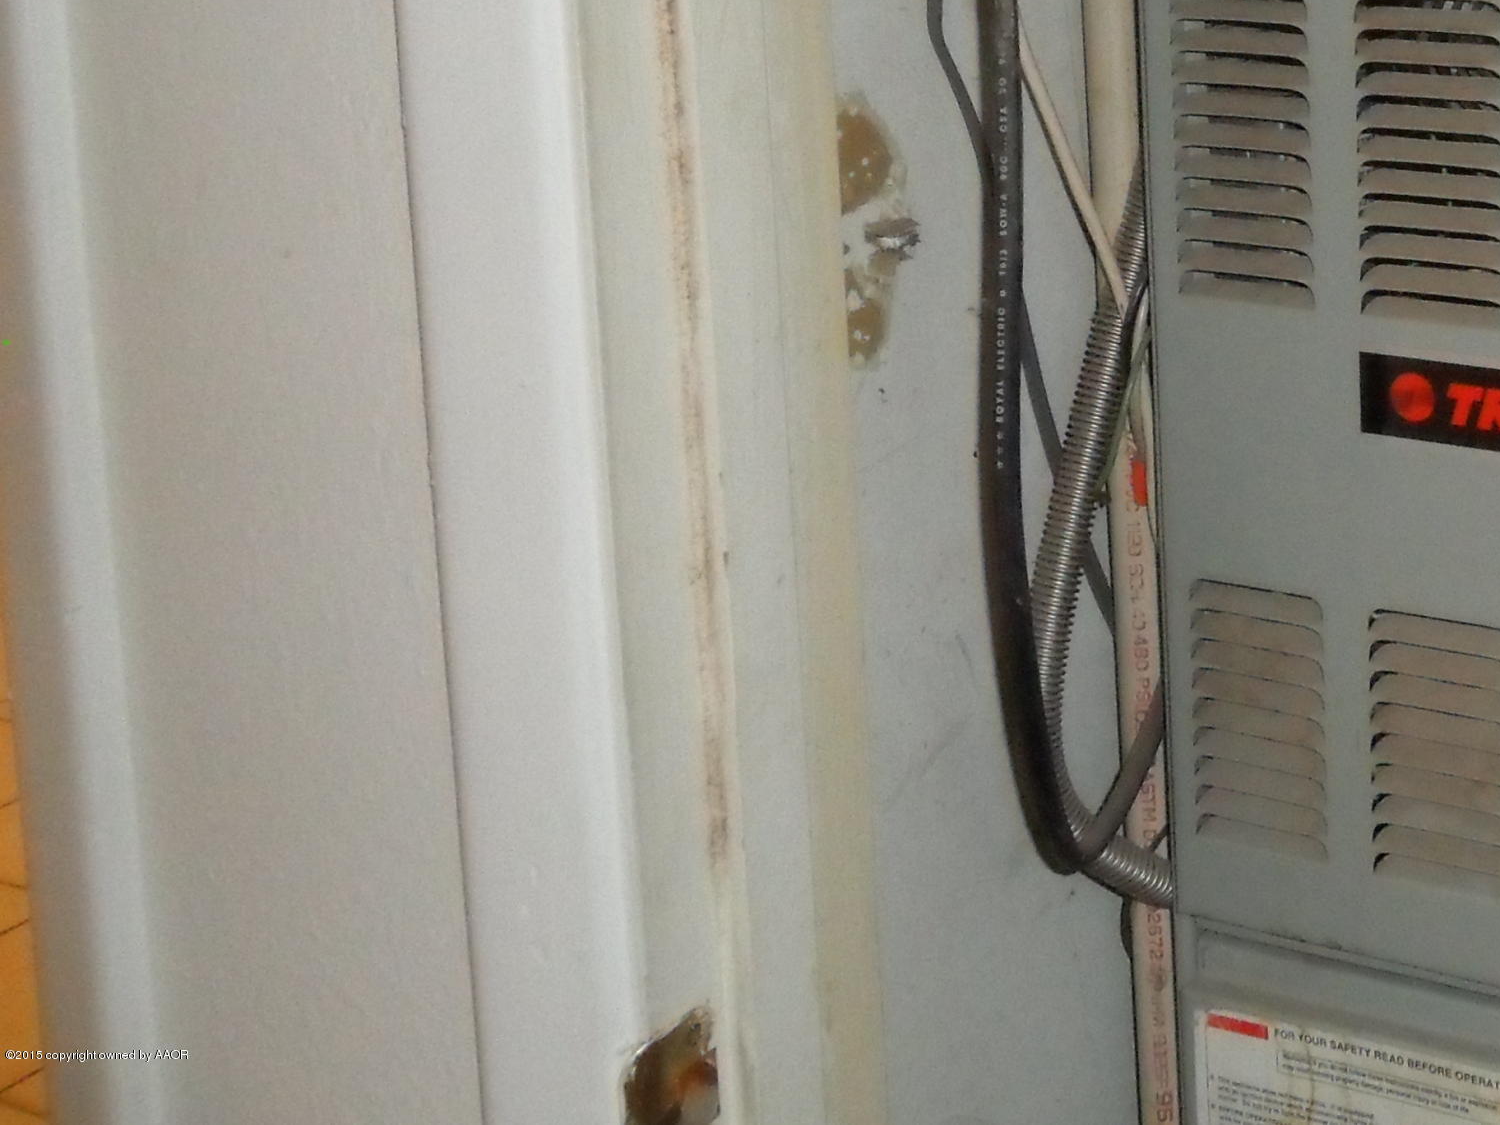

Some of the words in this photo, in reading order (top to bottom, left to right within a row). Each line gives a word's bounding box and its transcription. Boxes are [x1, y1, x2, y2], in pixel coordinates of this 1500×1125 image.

[996, 306, 1006, 370] ELECTRIC
[996, 378, 1005, 423] ROYAL
[1273, 1028, 1296, 1042] FOR
[1299, 1032, 1327, 1048] YOUR
[1330, 1038, 1371, 1059] SAFETY
[1374, 1049, 1404, 1067] READ
[1407, 1054, 1452, 1079] BEFORE
